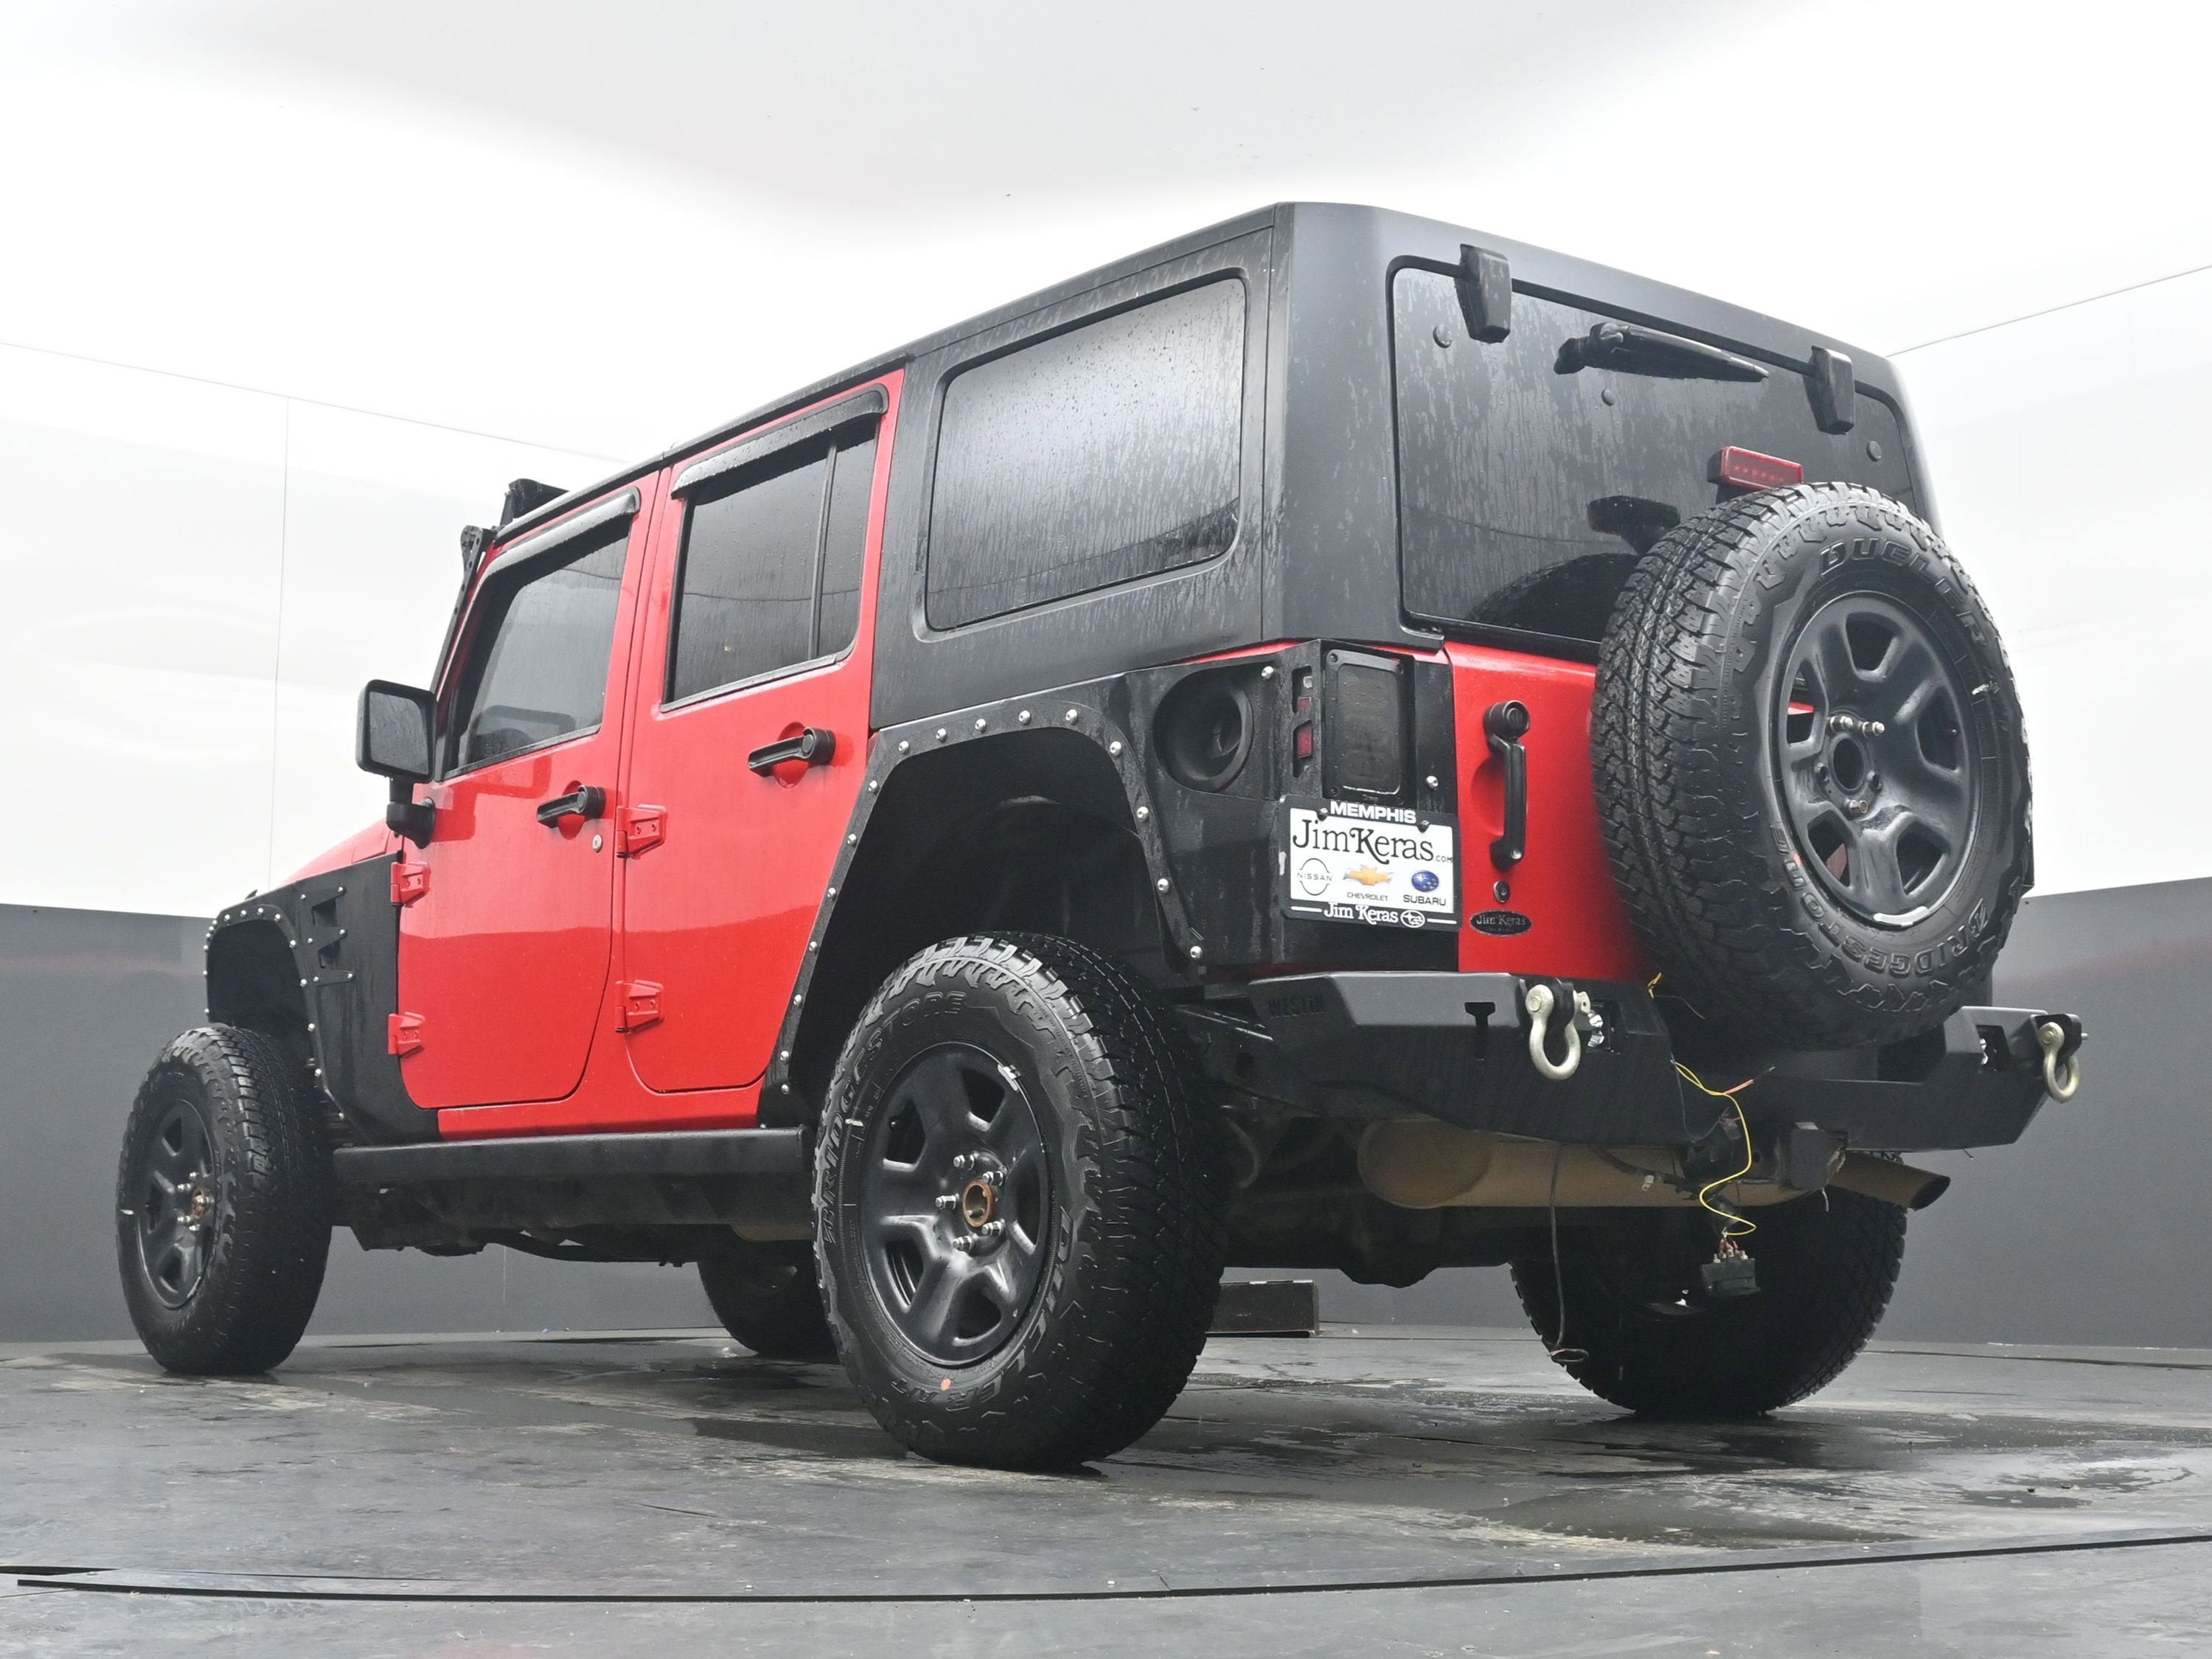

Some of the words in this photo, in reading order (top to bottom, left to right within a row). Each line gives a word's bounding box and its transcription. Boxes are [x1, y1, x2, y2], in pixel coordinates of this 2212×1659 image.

[1820, 538, 1987, 647] DUELER
[1330, 801, 1416, 824] MEMPHIS
[1298, 872, 1332, 882] NISSAN
[1346, 891, 1388, 901] CHEVROLET
[1403, 894, 1447, 906] SUBARU
[1770, 826, 1989, 978] BRIDGESTONE
[1324, 902, 1354, 919] Jim
[1355, 905, 1399, 925] Keras
[1476, 914, 1495, 925] Jim
[1496, 914, 1526, 927] Keras
[822, 990, 967, 1245] BRIDGESTONE
